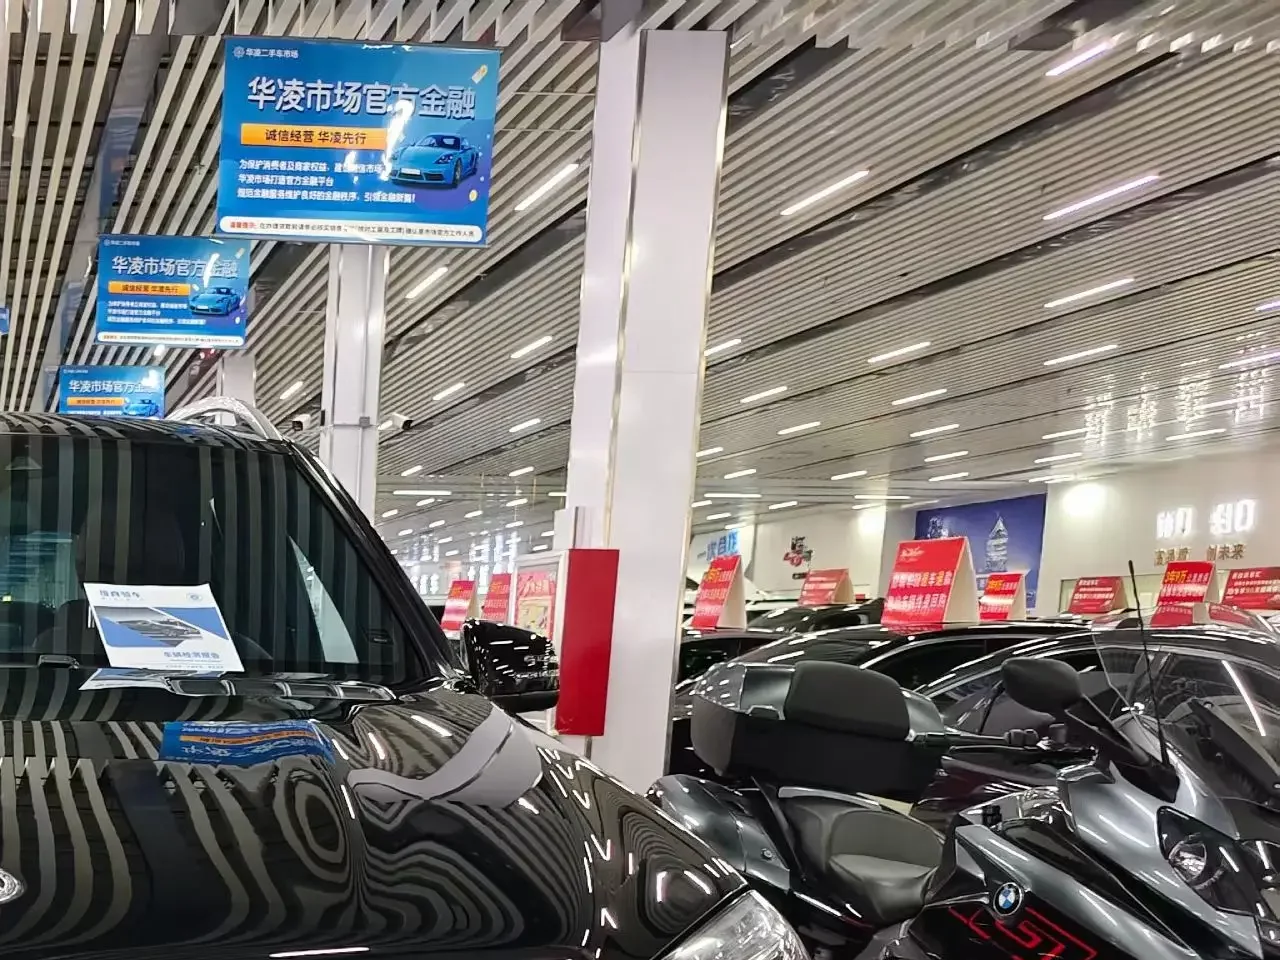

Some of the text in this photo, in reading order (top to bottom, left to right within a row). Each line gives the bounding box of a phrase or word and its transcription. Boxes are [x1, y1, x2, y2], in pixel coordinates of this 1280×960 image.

[245, 48, 299, 59] 华凌二手车市场
[247, 76, 476, 120] 华凌市场官方金融
[265, 130, 367, 145] 诚信经营 华凌先行
